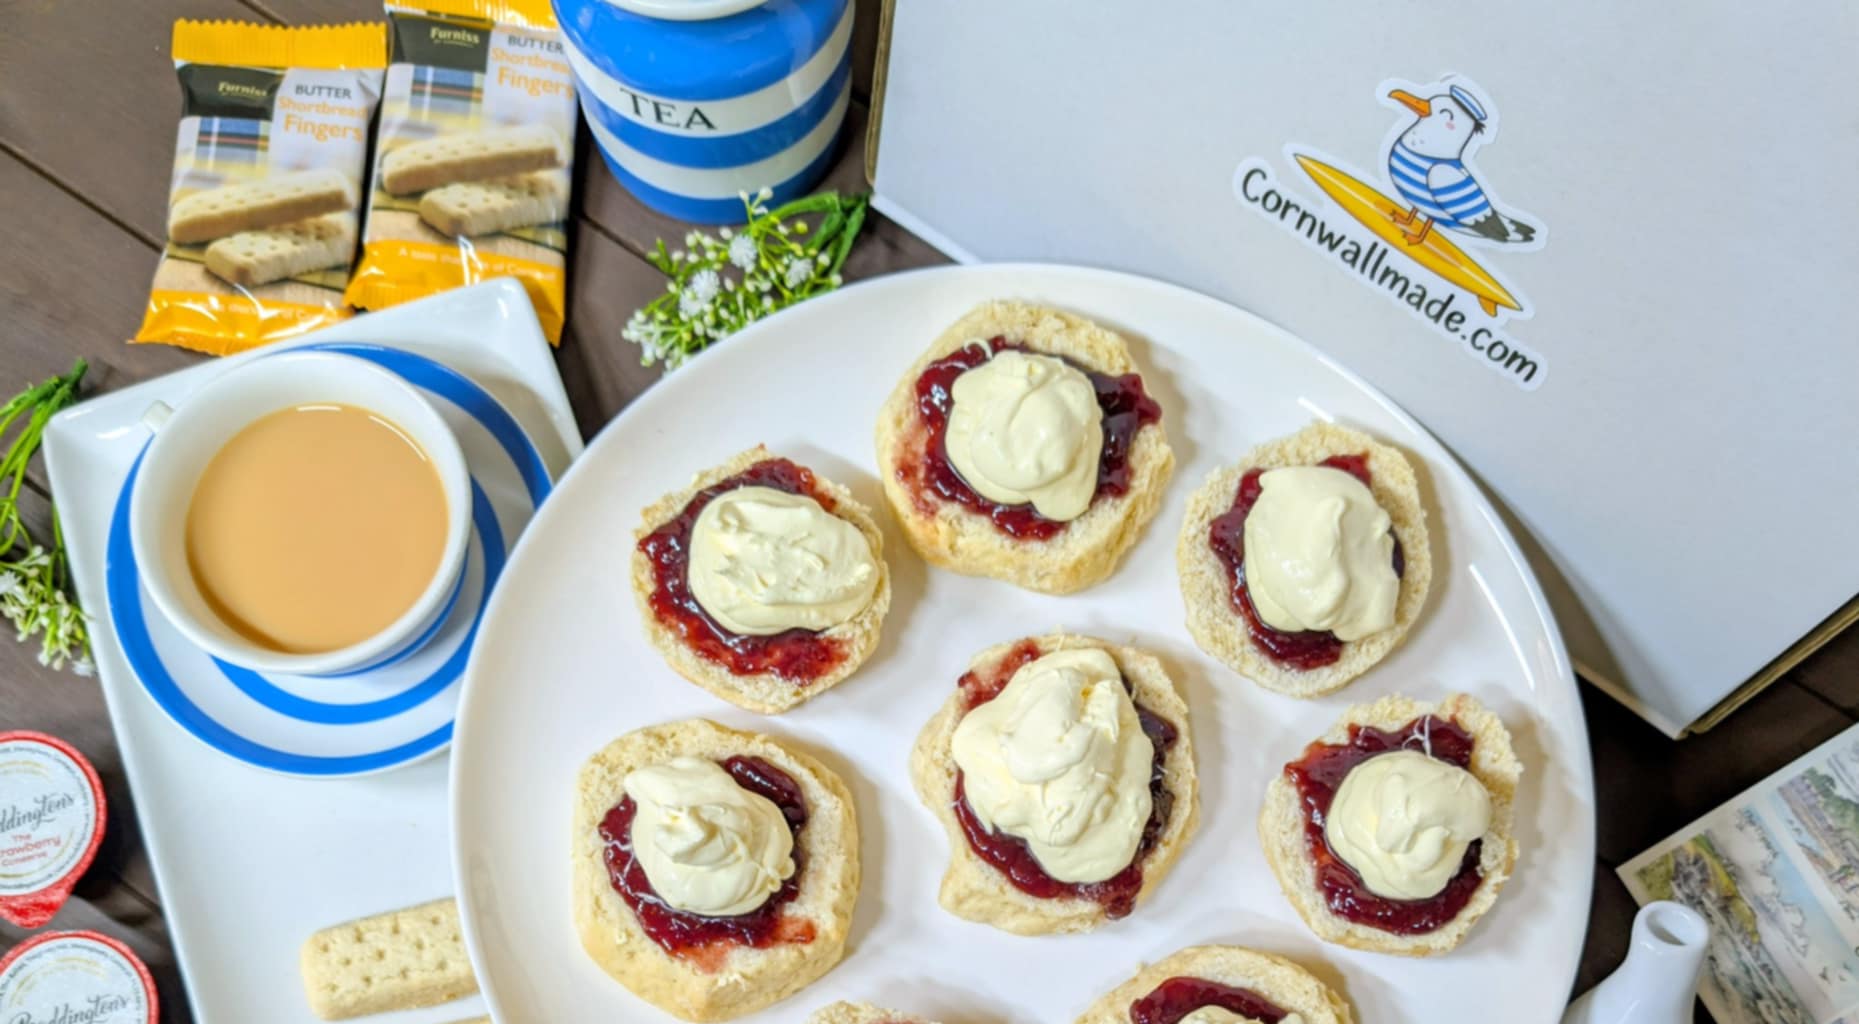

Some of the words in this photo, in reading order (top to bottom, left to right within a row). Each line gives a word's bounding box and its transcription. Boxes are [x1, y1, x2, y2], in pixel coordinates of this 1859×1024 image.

[430, 27, 480, 44] Furniss
[508, 35, 563, 55] BUTTER
[492, 47, 572, 74] Shortbrea
[218, 81, 268, 97] Furniss
[295, 84, 352, 99] BUTTER
[278, 96, 368, 119] Shortbread
[620, 88, 717, 130] TEA
[284, 114, 363, 142] Fingers
[1242, 168, 1539, 383] Cornwallmade.com
[0, 836, 61, 856] rawberry
